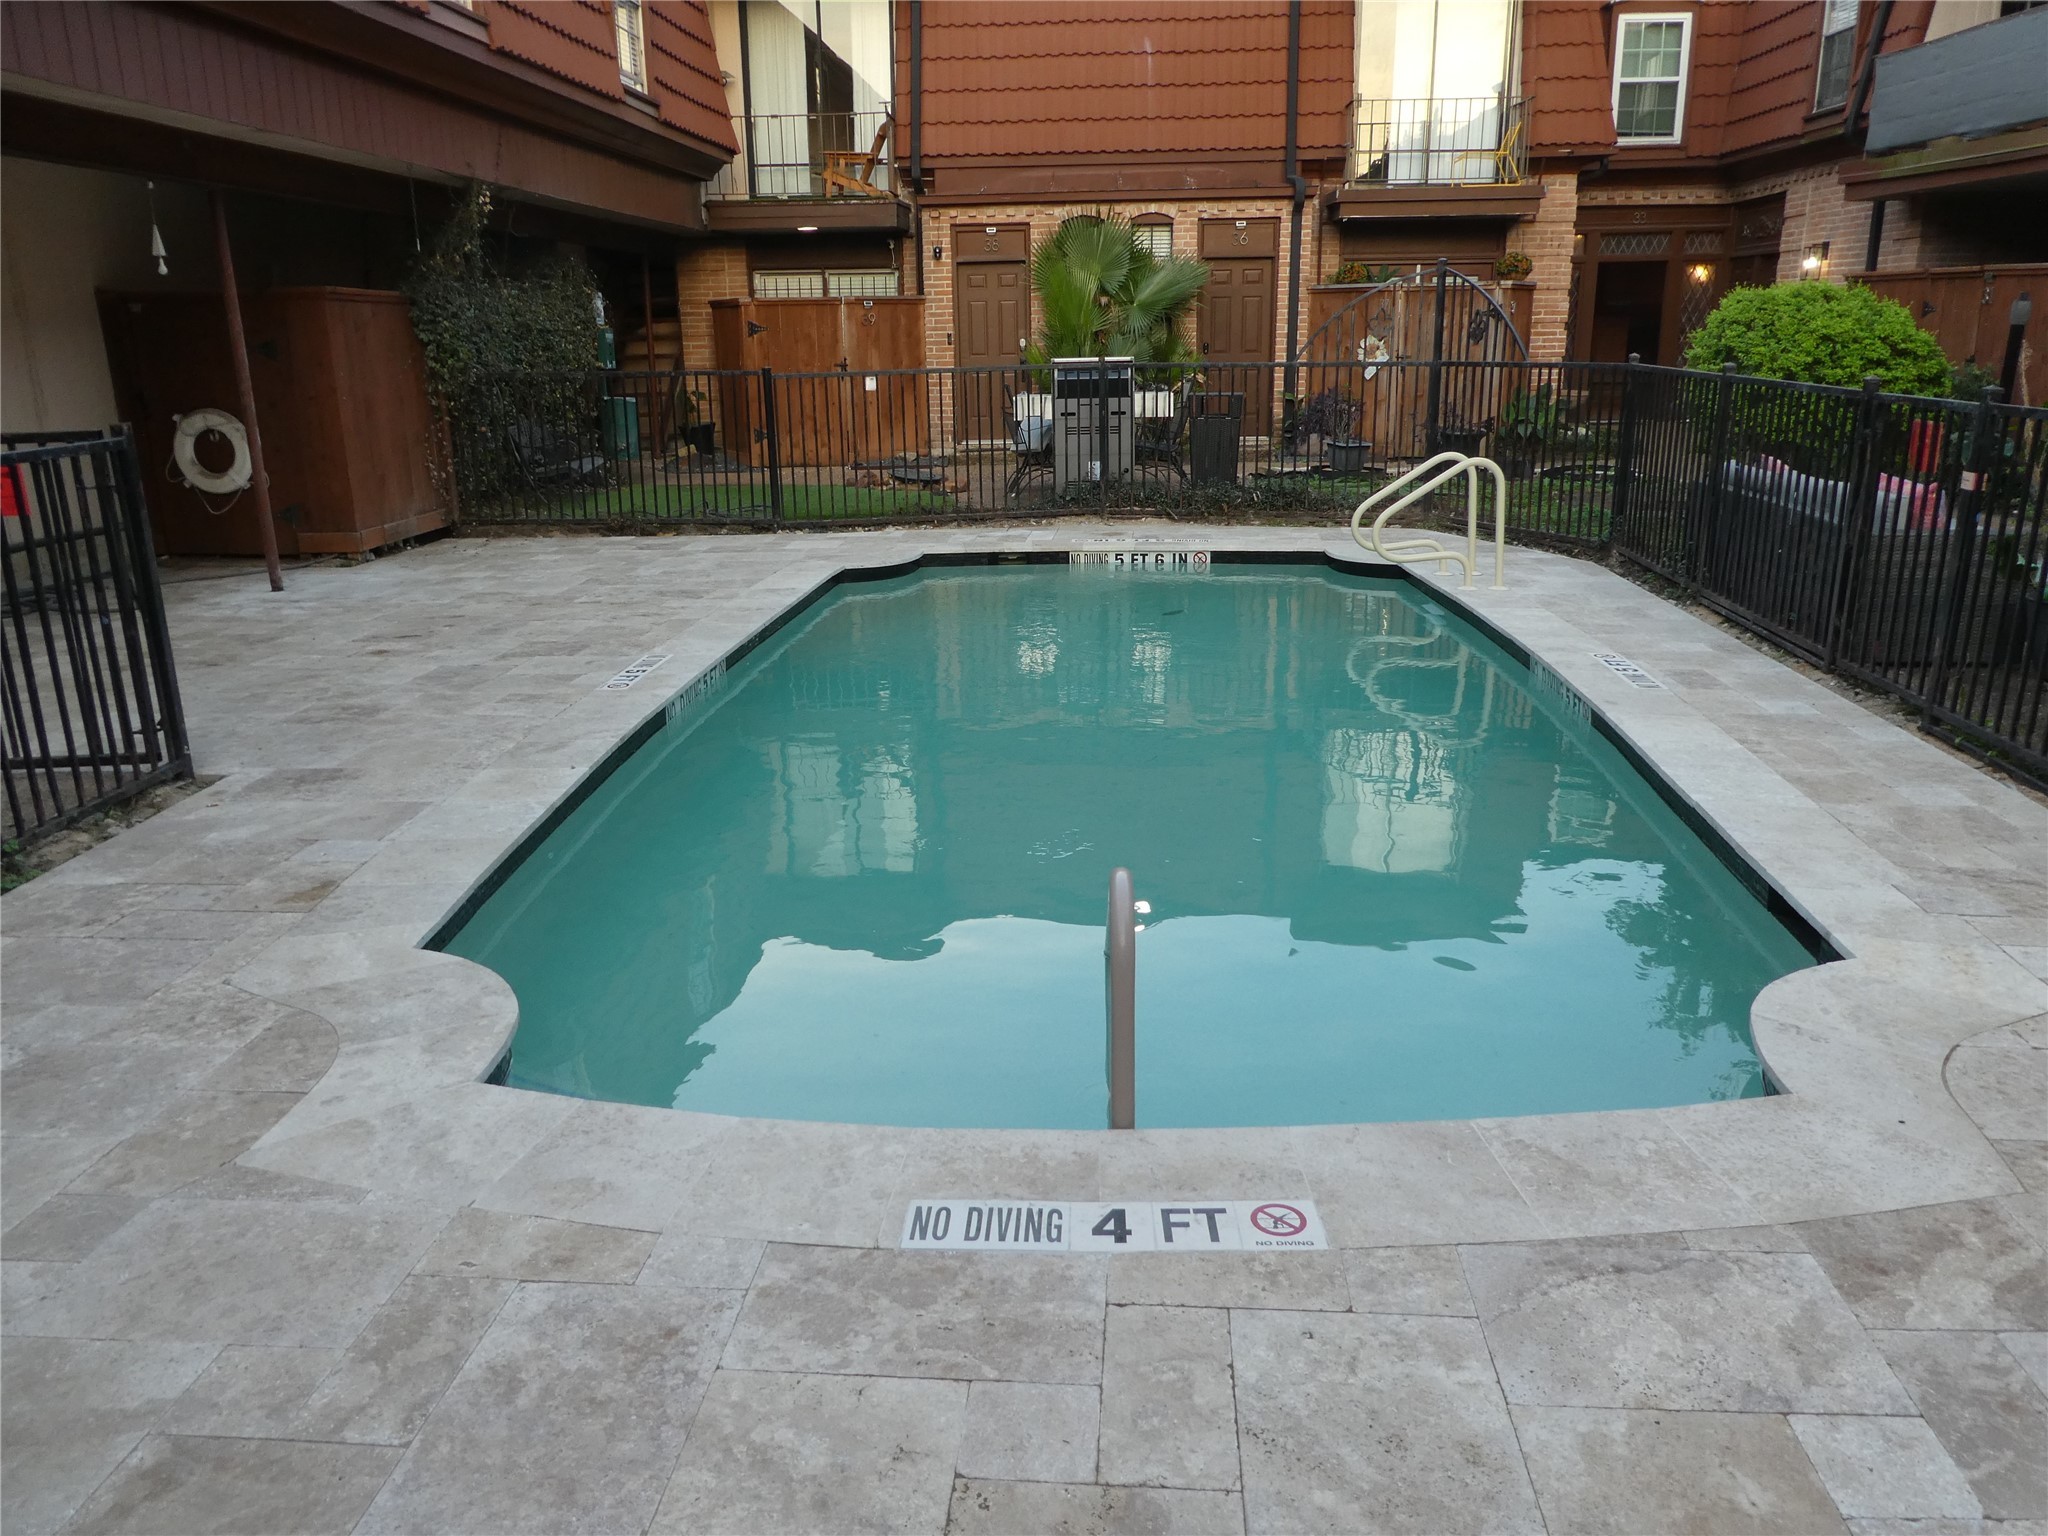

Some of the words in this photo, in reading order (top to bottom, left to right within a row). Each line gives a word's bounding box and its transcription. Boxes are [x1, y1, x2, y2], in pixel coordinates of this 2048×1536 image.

[1632, 211, 1647, 224] 33
[984, 238, 999, 251] 38
[1232, 231, 1249, 246] 36
[1070, 553, 1081, 564] NO
[1083, 553, 1109, 564] DIVING
[1114, 553, 1125, 564] 5
[1131, 553, 1149, 564] FT
[1172, 553, 1188, 564] IN
[909, 1206, 952, 1241] NO
[964, 1206, 1063, 1243] DIVING
[1091, 1208, 1132, 1244] 4
[1160, 1207, 1227, 1243] FT
